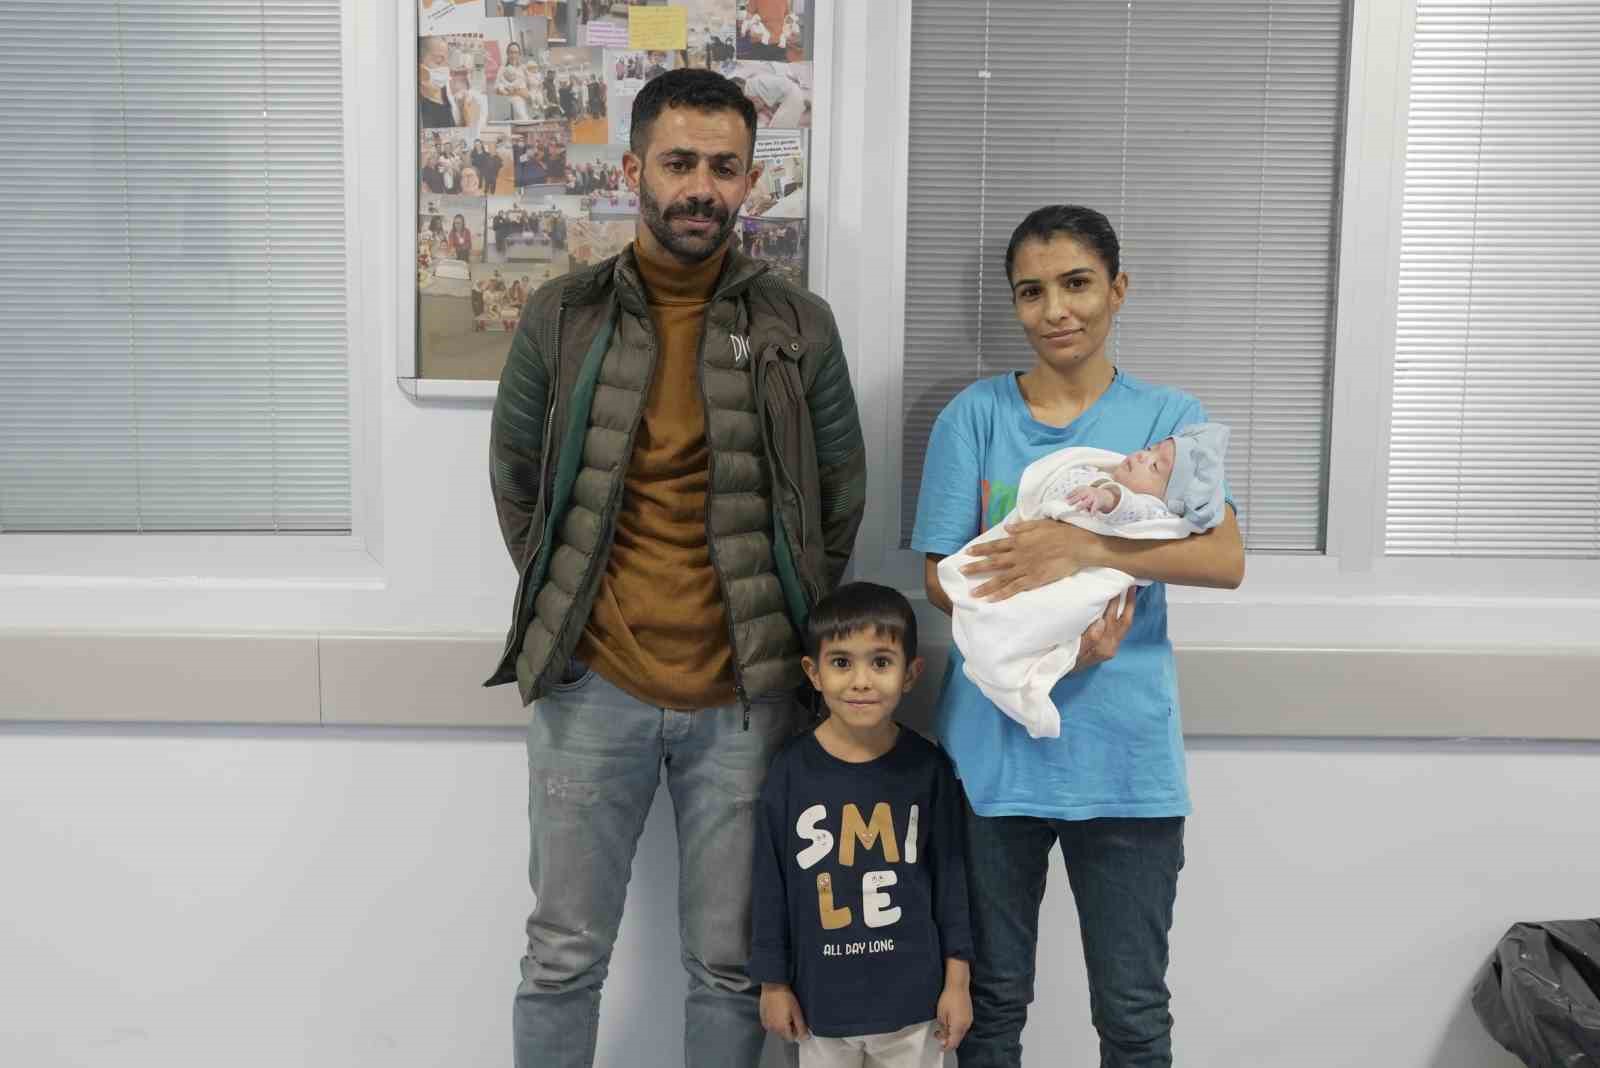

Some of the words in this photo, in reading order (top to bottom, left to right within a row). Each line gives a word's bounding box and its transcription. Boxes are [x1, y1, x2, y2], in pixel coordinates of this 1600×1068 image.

[823, 943, 843, 956] ALL
[845, 941, 866, 955] DAY
[869, 938, 895, 953] LONG
